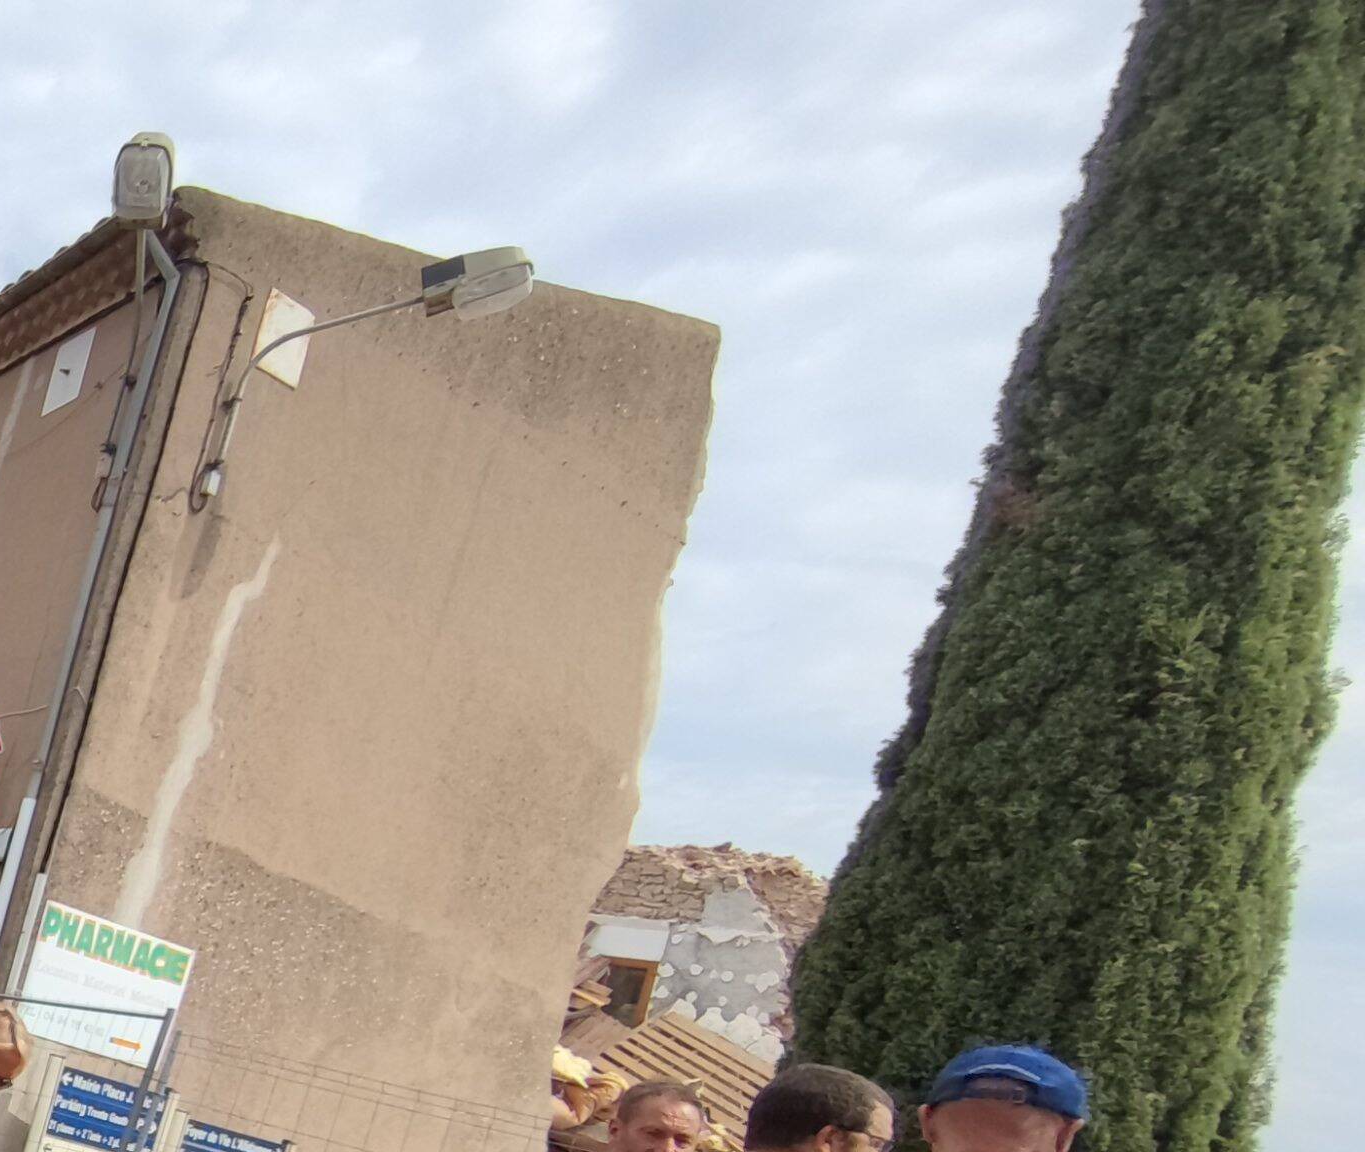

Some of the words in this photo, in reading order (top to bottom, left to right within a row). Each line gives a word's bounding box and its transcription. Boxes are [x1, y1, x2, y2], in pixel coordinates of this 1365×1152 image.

[36, 903, 192, 986] PHARMACIE
[72, 1074, 102, 1094] Mairie
[101, 1083, 127, 1102] Place
[54, 1094, 88, 1117] Parking
